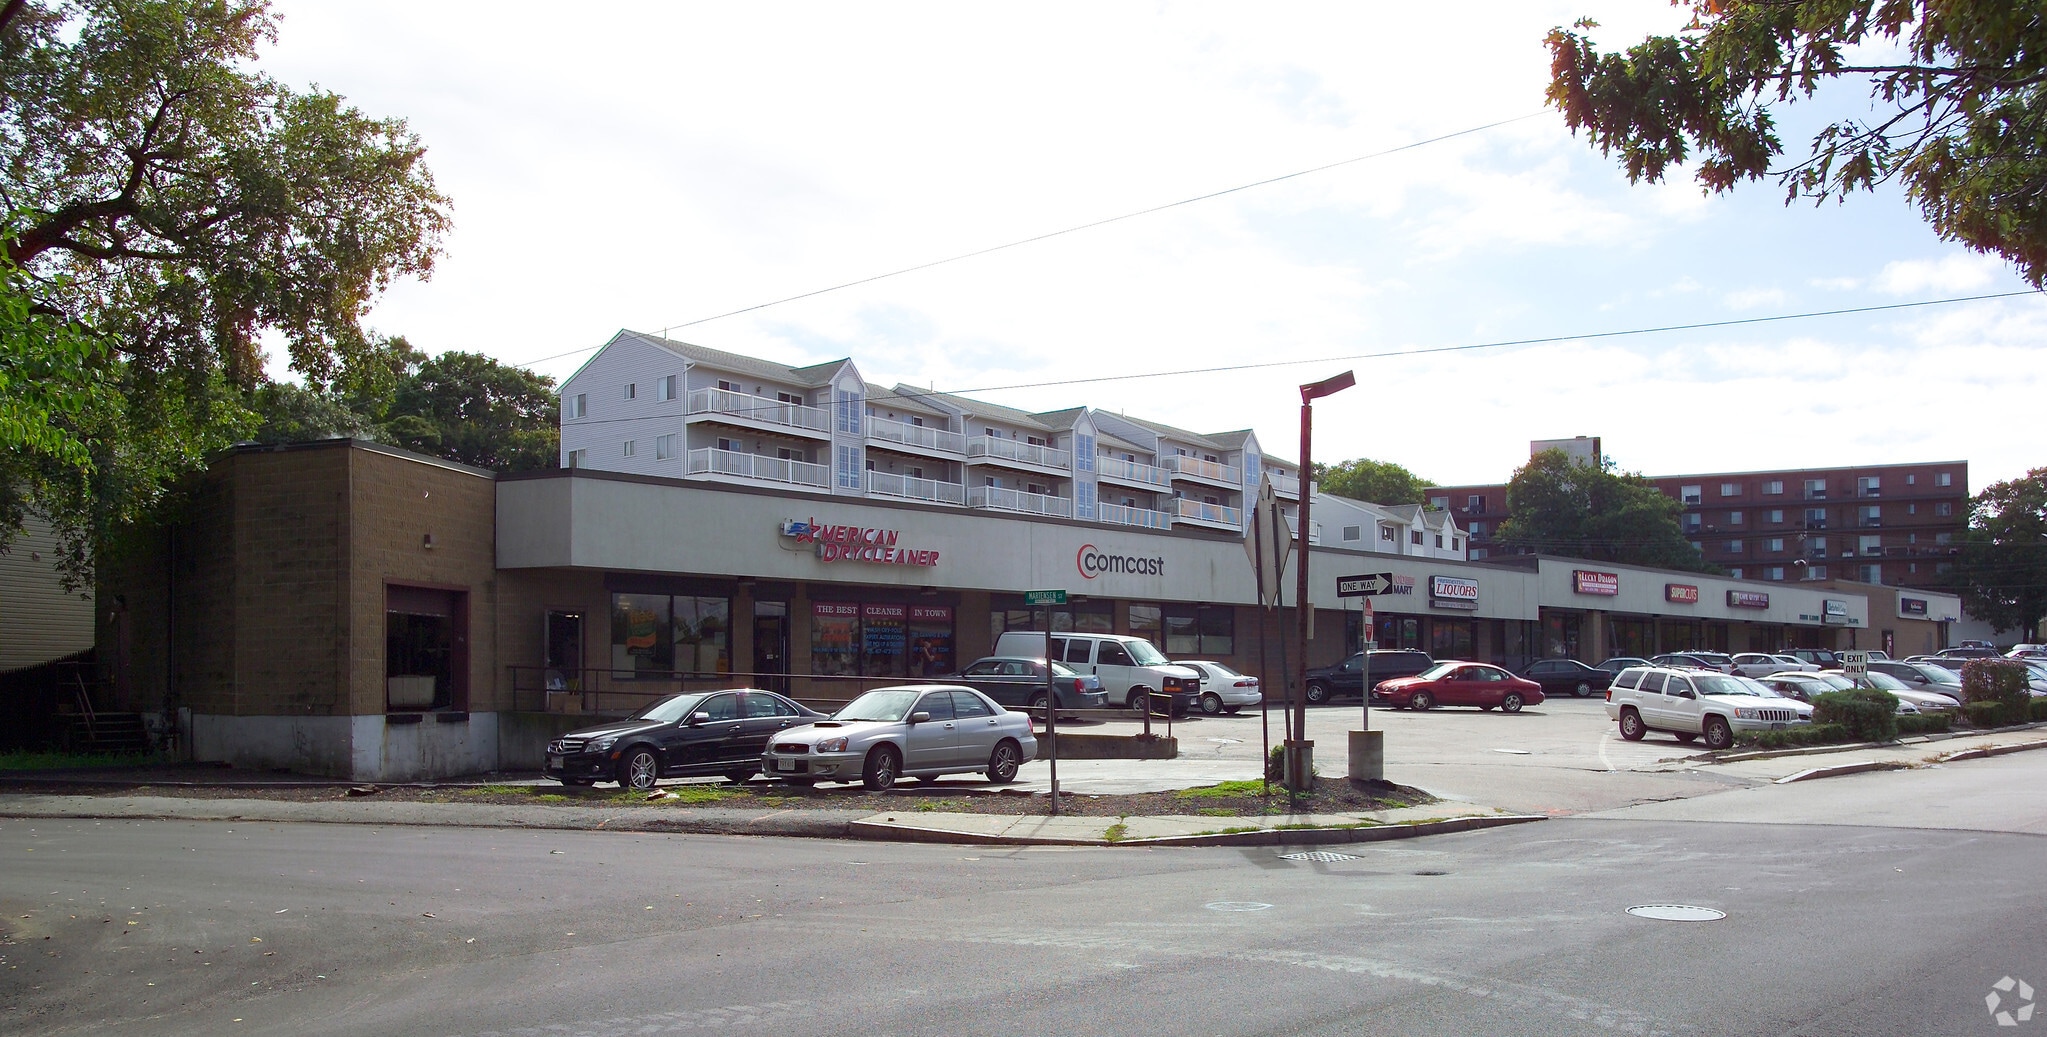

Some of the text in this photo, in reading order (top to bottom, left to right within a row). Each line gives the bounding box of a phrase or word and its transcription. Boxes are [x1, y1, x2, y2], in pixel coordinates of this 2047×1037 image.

[822, 543, 940, 566] DRYCLEANER
[1581, 571, 1617, 584] LUCKY DRAGON
[1342, 580, 1376, 591] ONE WAY
[1393, 585, 1413, 595] MART
[1436, 583, 1477, 597] LIQUORS
[1028, 591, 1057, 600] MARTENSEN
[1671, 587, 1697, 600] SUPERCUTS
[816, 605, 834, 613] THE
[836, 606, 857, 614] BEST
[866, 607, 902, 616] CLEANER
[925, 609, 947, 617] TOWN
[1845, 654, 1865, 674] EXIT ONLY
